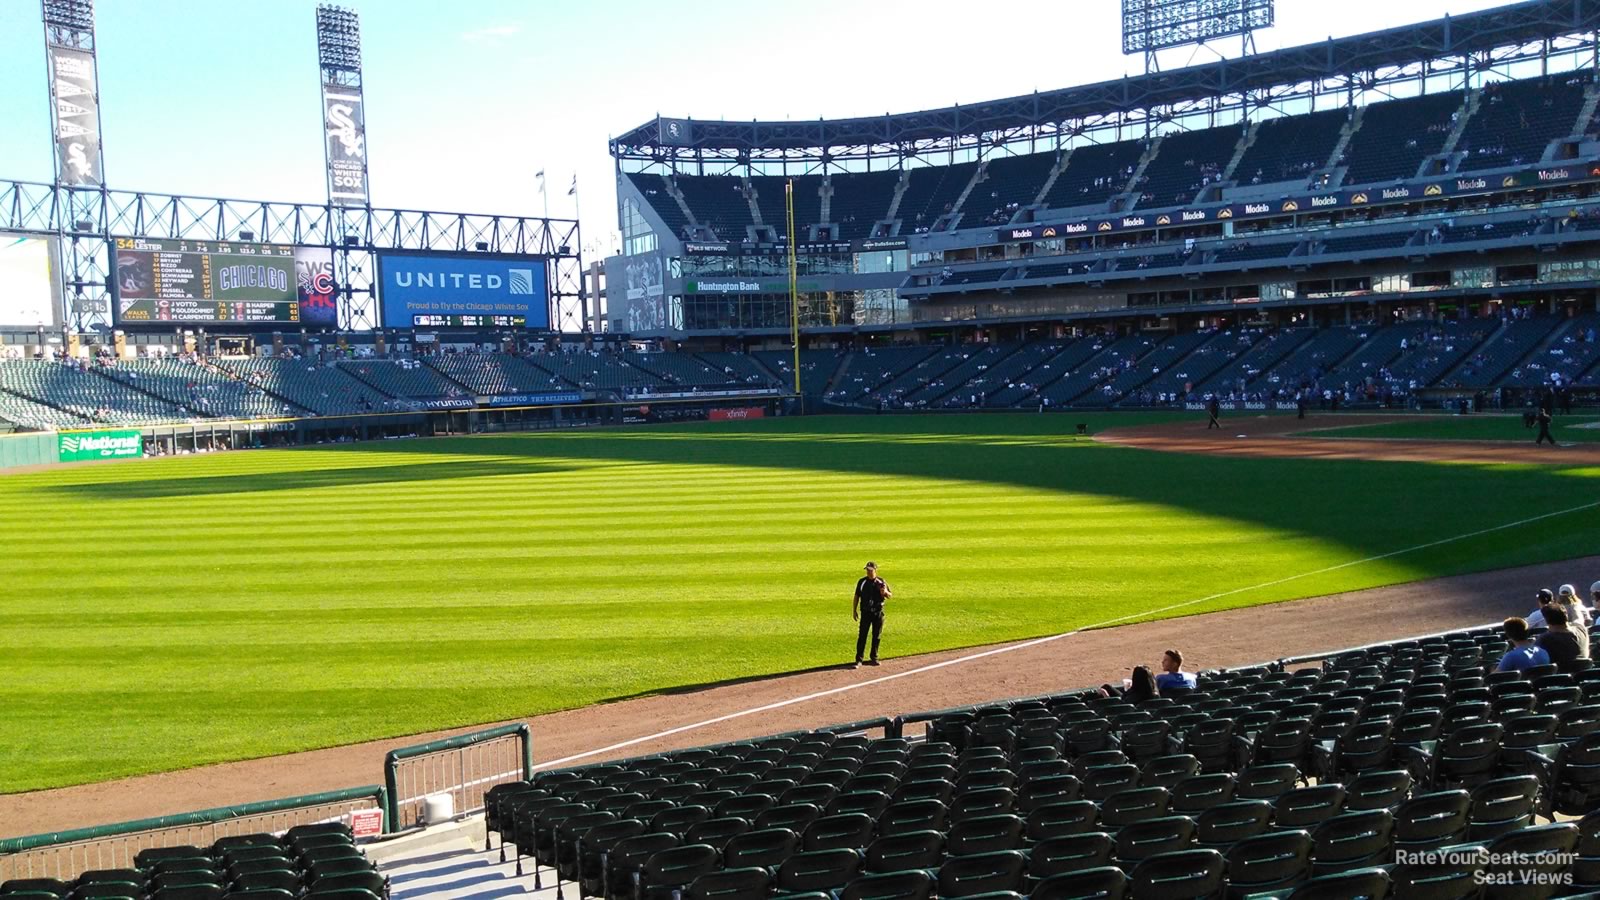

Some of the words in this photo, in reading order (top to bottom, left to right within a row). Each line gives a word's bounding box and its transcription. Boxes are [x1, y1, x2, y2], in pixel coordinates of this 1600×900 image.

[1538, 170, 1568, 180] Modelo
[334, 176, 362, 188] SOX
[1458, 179, 1486, 190] Modelo
[1383, 189, 1409, 199] Modelo
[1312, 196, 1336, 206] Modelo
[1246, 204, 1269, 214] Modelo
[1183, 210, 1205, 220] Modelo
[1123, 217, 1144, 226] Modelo
[1012, 229, 1032, 238] Modelo
[1066, 224, 1087, 233] Modelo
[118, 239, 134, 249] 34
[220, 265, 287, 292] CHICAGO
[396, 272, 502, 289] UNITED
[698, 282, 739, 292] Huntington
[740, 282, 760, 290] Bank
[407, 302, 430, 310] Proud
[440, 302, 450, 312] fly
[466, 302, 493, 312] Chicago
[726, 410, 748, 418] xfinity
[79, 434, 140, 450] National
